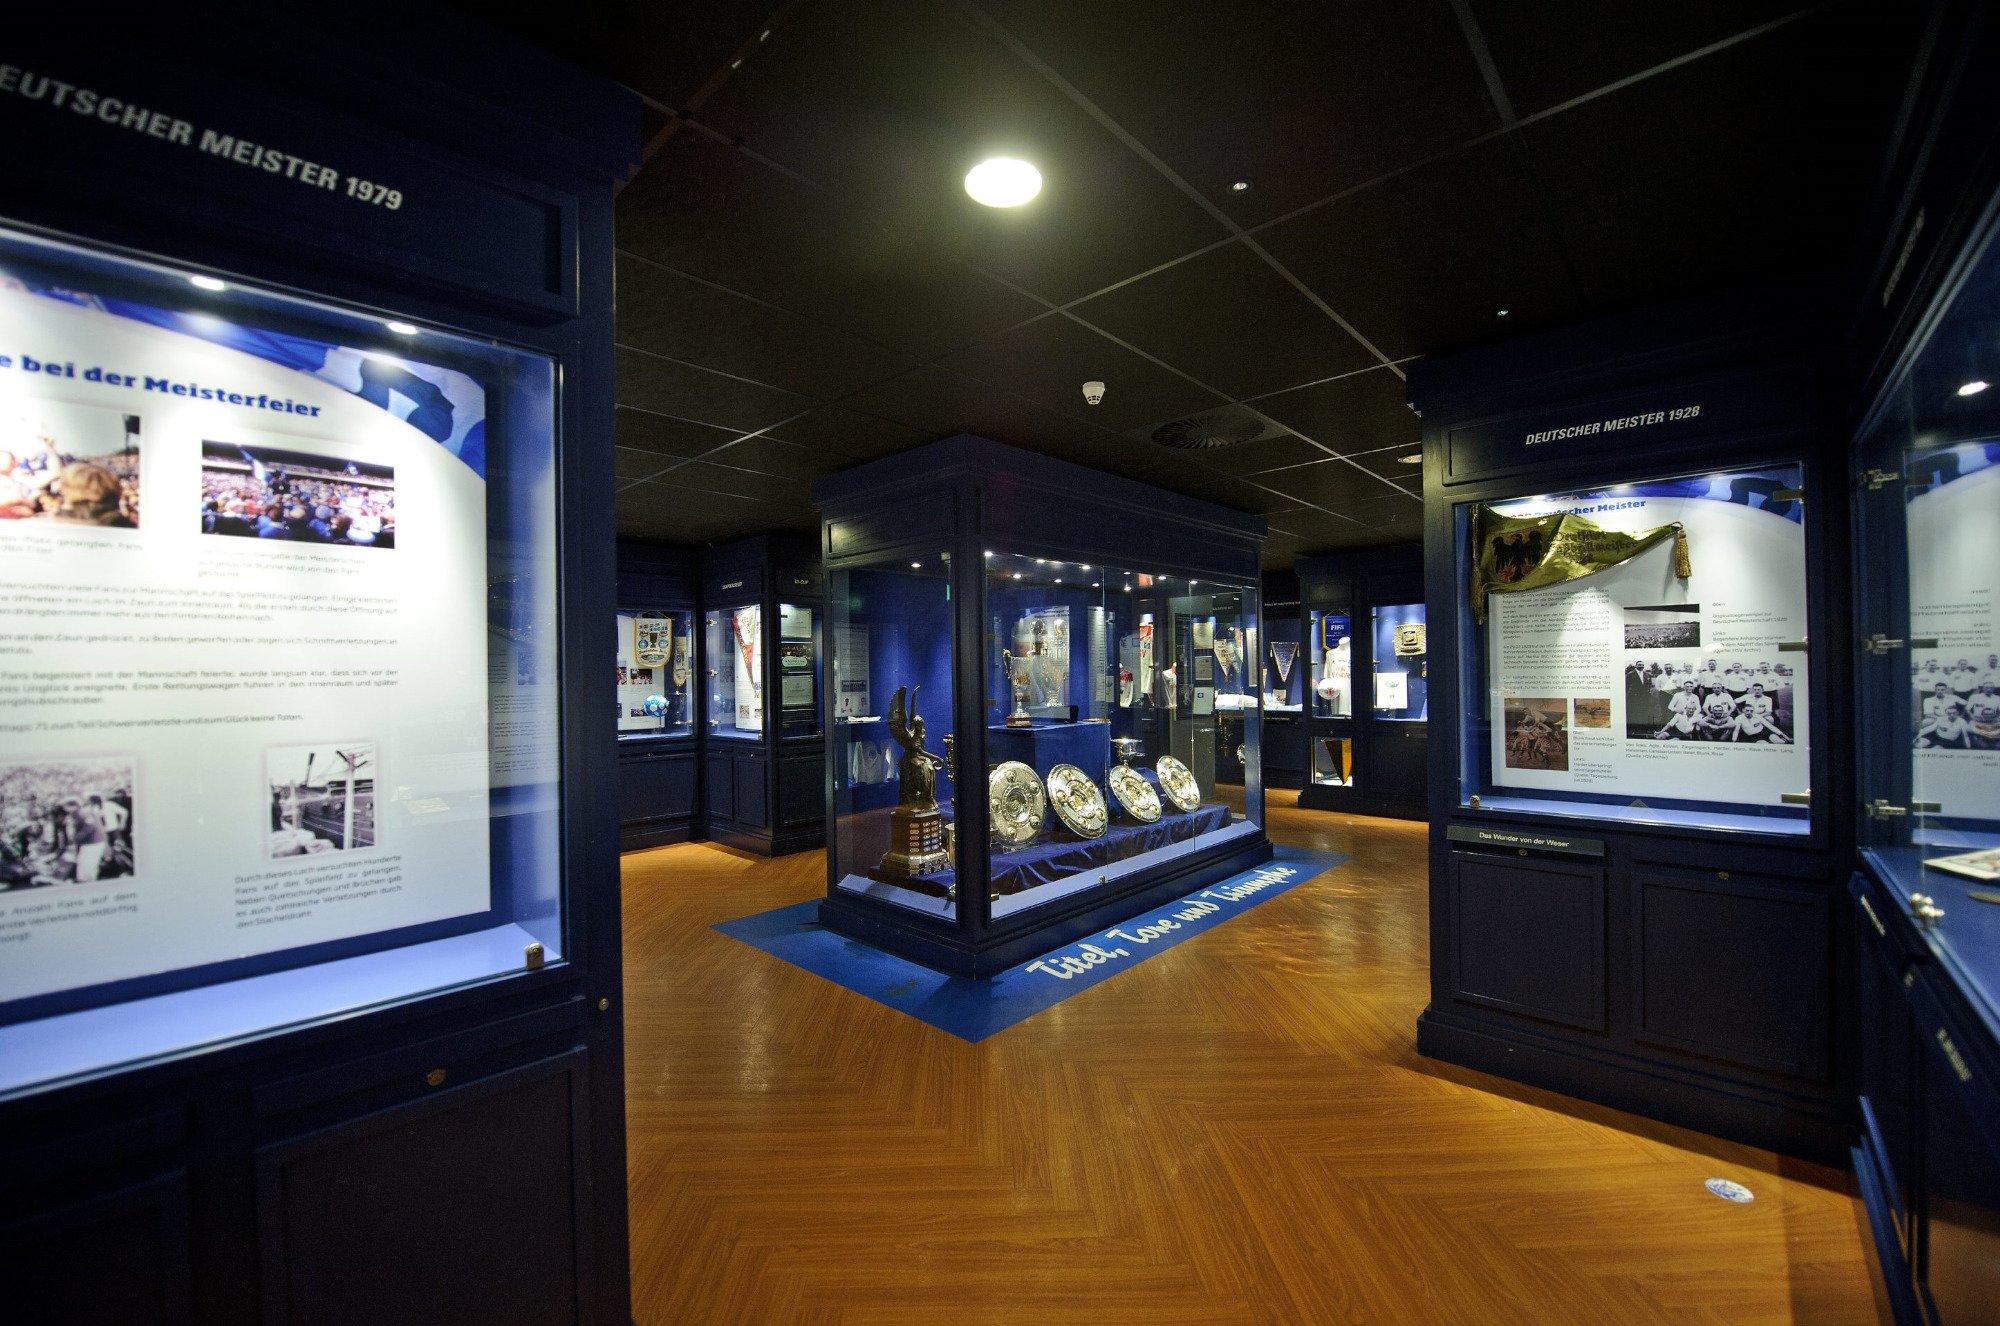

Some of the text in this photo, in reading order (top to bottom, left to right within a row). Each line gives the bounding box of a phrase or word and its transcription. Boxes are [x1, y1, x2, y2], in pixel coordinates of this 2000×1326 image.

[199, 129, 339, 191] MEISTER
[346, 176, 404, 211] 1979
[20, 354, 76, 379] bei
[83, 367, 136, 387] der
[143, 375, 321, 418] Meisterfeier
[1526, 405, 1700, 445] DEUTSCHER MEISTER 1928
[1597, 500, 1647, 512] Meister
[1479, 831, 1492, 840] Das
[1493, 833, 1519, 843] Wunder
[1533, 838, 1546, 846] der
[1546, 839, 1570, 848] Weser
[1025, 866, 1297, 980] Titel, Tore und Triumphe
